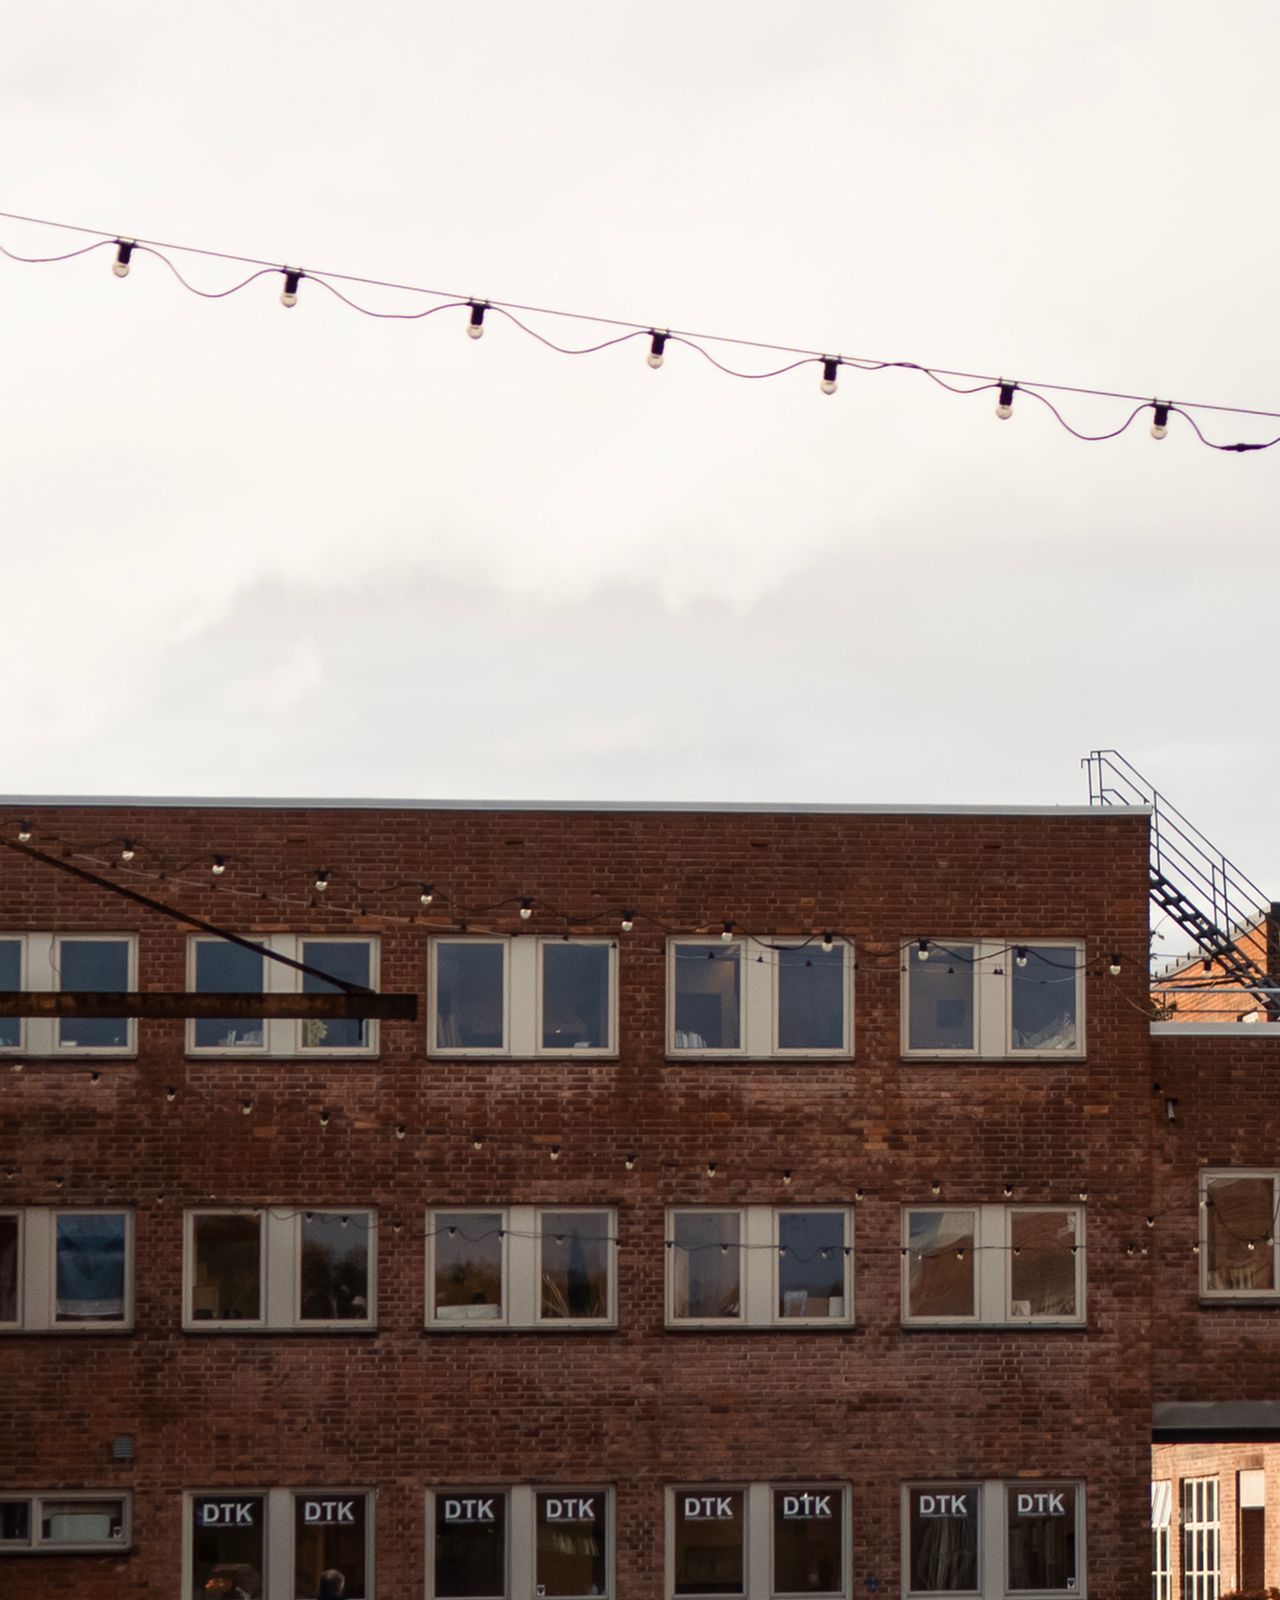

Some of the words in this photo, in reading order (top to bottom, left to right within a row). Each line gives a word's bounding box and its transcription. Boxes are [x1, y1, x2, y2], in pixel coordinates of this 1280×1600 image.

[304, 1501, 354, 1521] DTK
[445, 1499, 494, 1519] DTK
[546, 1498, 595, 1518] DTK
[684, 1497, 733, 1516] DTK
[783, 1495, 831, 1515] DTK
[920, 1495, 967, 1513] DTK
[1017, 1493, 1065, 1512] DTK
[203, 1503, 253, 1522] DTK
